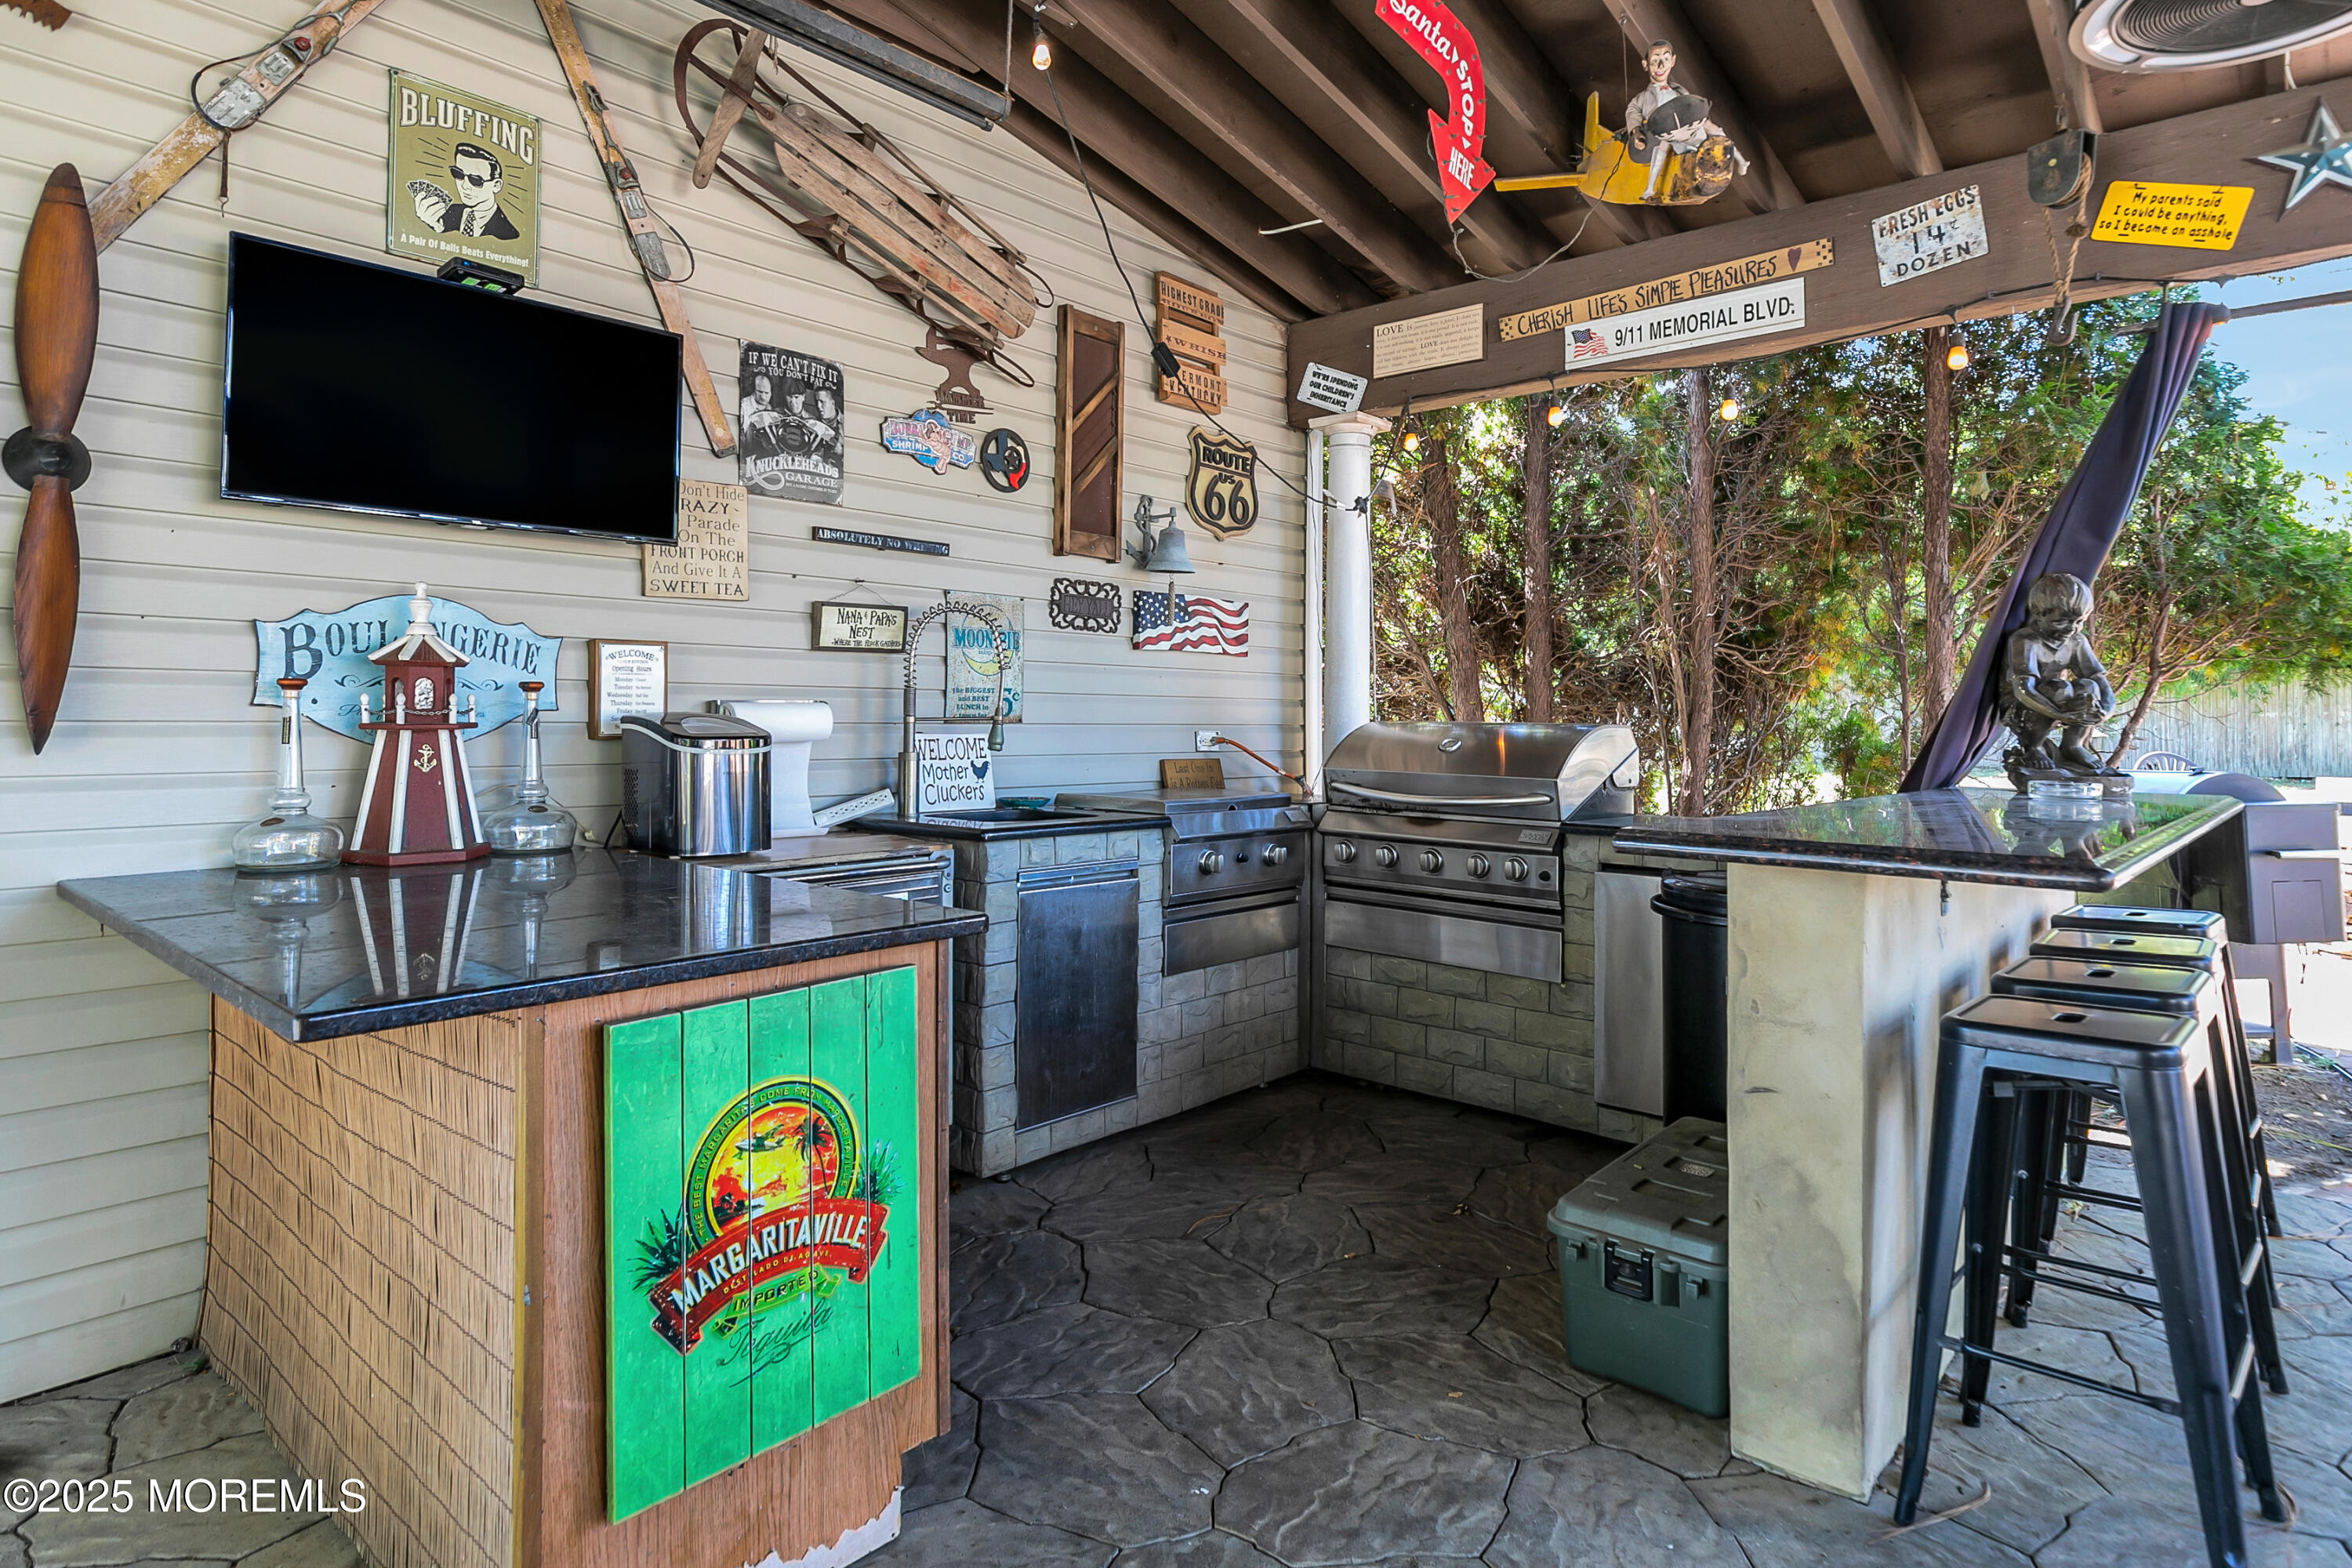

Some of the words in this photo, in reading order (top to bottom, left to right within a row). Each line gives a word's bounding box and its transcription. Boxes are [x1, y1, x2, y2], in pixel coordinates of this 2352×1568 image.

[1390, 0, 1450, 60] Santa
[1456, 60, 1474, 136] STOP
[400, 86, 535, 165] BLUFFING
[1448, 146, 1475, 191] HERE
[2132, 192, 2147, 203] My
[2149, 194, 2194, 205] parents
[2197, 197, 2222, 208] said
[1878, 204, 1929, 238] FRESH
[1934, 187, 1975, 216] EGGS
[2114, 205, 2121, 216] I
[2124, 207, 2156, 218] could
[2158, 207, 2172, 220] be
[2176, 211, 2227, 225] anything,
[2099, 220, 2111, 229] so
[2114, 220, 2121, 230] I
[2123, 220, 2168, 234] became
[2189, 228, 2233, 240] asshole
[401, 234, 407, 242] A
[408, 234, 426, 247] Pair
[428, 238, 438, 249] Of
[440, 241, 460, 253] Balls
[462, 246, 484, 259] Beats
[485, 251, 529, 267] Everything!
[1896, 241, 1971, 277] DOZEN
[1690, 256, 1777, 296] PLEASURES
[1161, 281, 1197, 309] HIGHEST
[1377, 324, 1403, 337] LOVE
[1615, 325, 1642, 347] 9/11
[1650, 307, 1737, 341] MEMORIAL
[1744, 296, 1795, 323] BLVD.
[749, 352, 759, 365] IF
[762, 353, 778, 367] WE
[781, 355, 808, 373] CAN'T
[811, 363, 826, 379] FIX
[829, 368, 838, 383] IT
[768, 367, 784, 376] YOU
[786, 370, 808, 381] DON'T
[810, 376, 824, 387] PAY
[1182, 370, 1221, 392] ERMONT
[1309, 380, 1322, 390] OUR
[1322, 384, 1355, 400] CHILDREN'S
[1312, 370, 1330, 382] WE'RE
[1330, 376, 1359, 390] SPENDING
[935, 391, 985, 408] HAMMER
[1310, 390, 1347, 408] INHERITANCE
[947, 410, 976, 423] TIME
[746, 454, 839, 478] KNUCKLEHEADS
[953, 452, 967, 462] CO.
[1202, 446, 1250, 472] ROUTE
[786, 472, 838, 487] GARAGE
[1218, 473, 1236, 485] US
[716, 485, 745, 502] Hide
[1204, 474, 1250, 524] 66
[681, 498, 730, 514] RAZY
[688, 514, 740, 532] Parade
[678, 529, 699, 543] On
[706, 532, 735, 546] The
[817, 528, 883, 546] ABSOLUTELY
[887, 538, 901, 548] NO
[651, 544, 696, 560] FRONT
[701, 547, 744, 563] PORCH
[652, 561, 679, 575] And
[684, 561, 713, 577] Give
[719, 564, 728, 578] It
[731, 566, 742, 579] A
[650, 579, 709, 594] SWEET
[714, 582, 744, 596] TEA
[837, 608, 862, 625] NANA
[869, 610, 898, 627] PAPA'S
[849, 624, 875, 639] NEST
[953, 627, 993, 648] MOON
[279, 619, 541, 680] BOULNGERIE
[608, 649, 655, 662] WELCOME
[914, 738, 987, 760] WELCOME
[923, 763, 968, 784] Mother
[1174, 761, 1189, 773] Last
[1190, 761, 1205, 773] One
[1205, 761, 1214, 773] In
[925, 784, 985, 805] Cluckers
[759, 1087, 789, 1102] COME
[793, 1087, 822, 1102] FROM
[692, 1177, 702, 1208] BEST
[697, 1211, 707, 1236] THE
[671, 1212, 871, 1313] MARGARITAVILLE
[723, 1260, 779, 1294] DESTLADO
[733, 1270, 818, 1312] IMPORTED
[717, 1298, 833, 1368] Tequila
